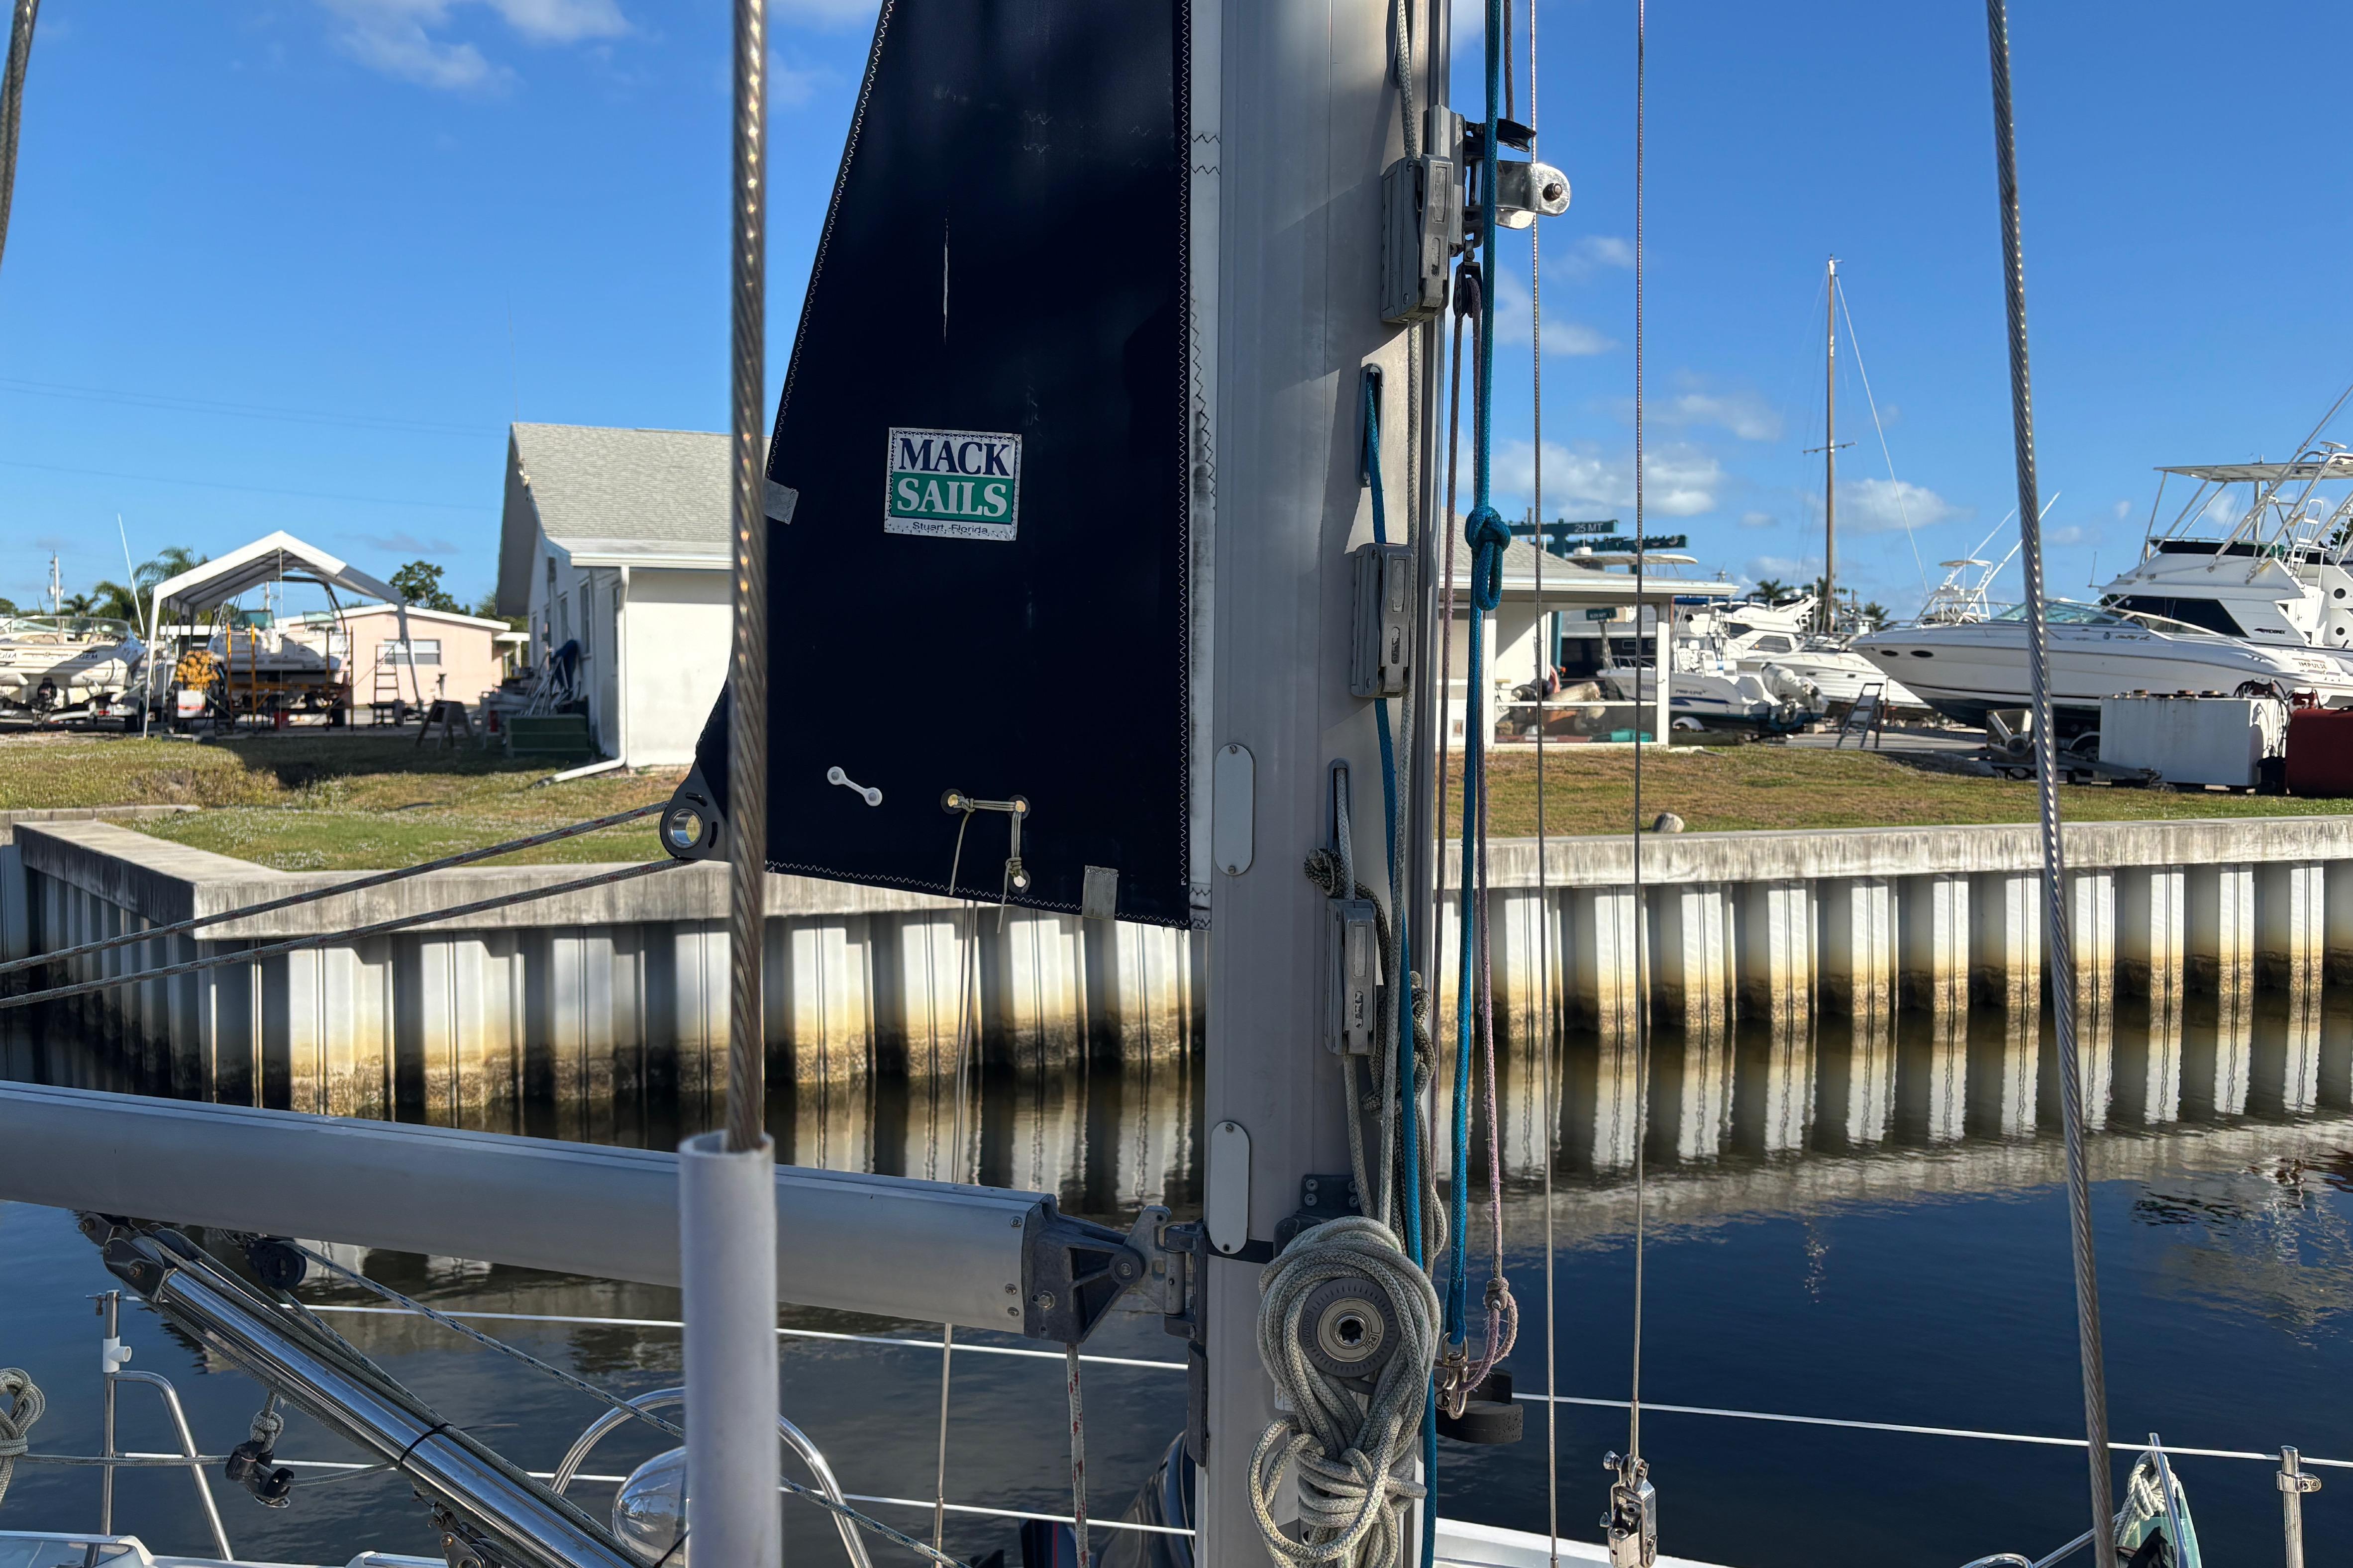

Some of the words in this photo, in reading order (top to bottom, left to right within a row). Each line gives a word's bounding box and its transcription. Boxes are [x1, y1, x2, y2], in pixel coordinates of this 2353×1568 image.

[899, 438, 1010, 477] MACK
[897, 478, 1007, 517] SAILS
[951, 524, 988, 534] Florida
[1574, 524, 1586, 533] 25
[1588, 523, 1603, 532] MT
[1303, 1311, 1313, 1347] LEWMAR
[1369, 1336, 1377, 1346] 24
